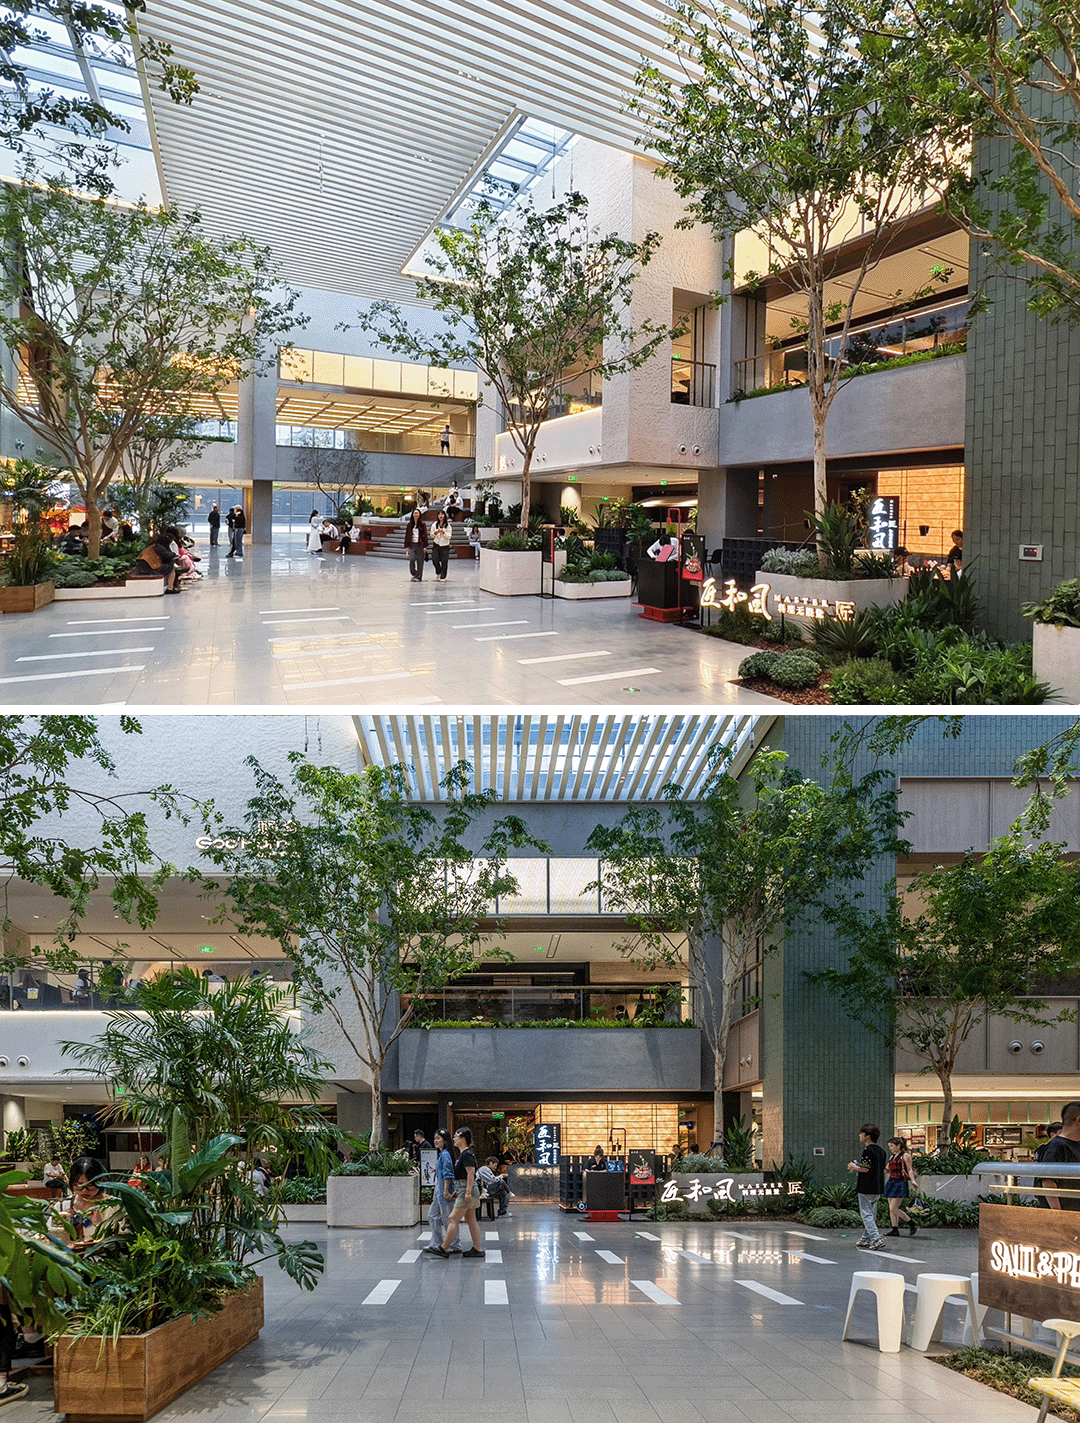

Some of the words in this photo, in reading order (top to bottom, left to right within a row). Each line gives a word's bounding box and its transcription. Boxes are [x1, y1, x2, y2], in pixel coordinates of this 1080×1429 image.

[773, 593, 829, 608] MASTER
[738, 1182, 784, 1190] MASTER
[787, 1181, 806, 1196] 匠
